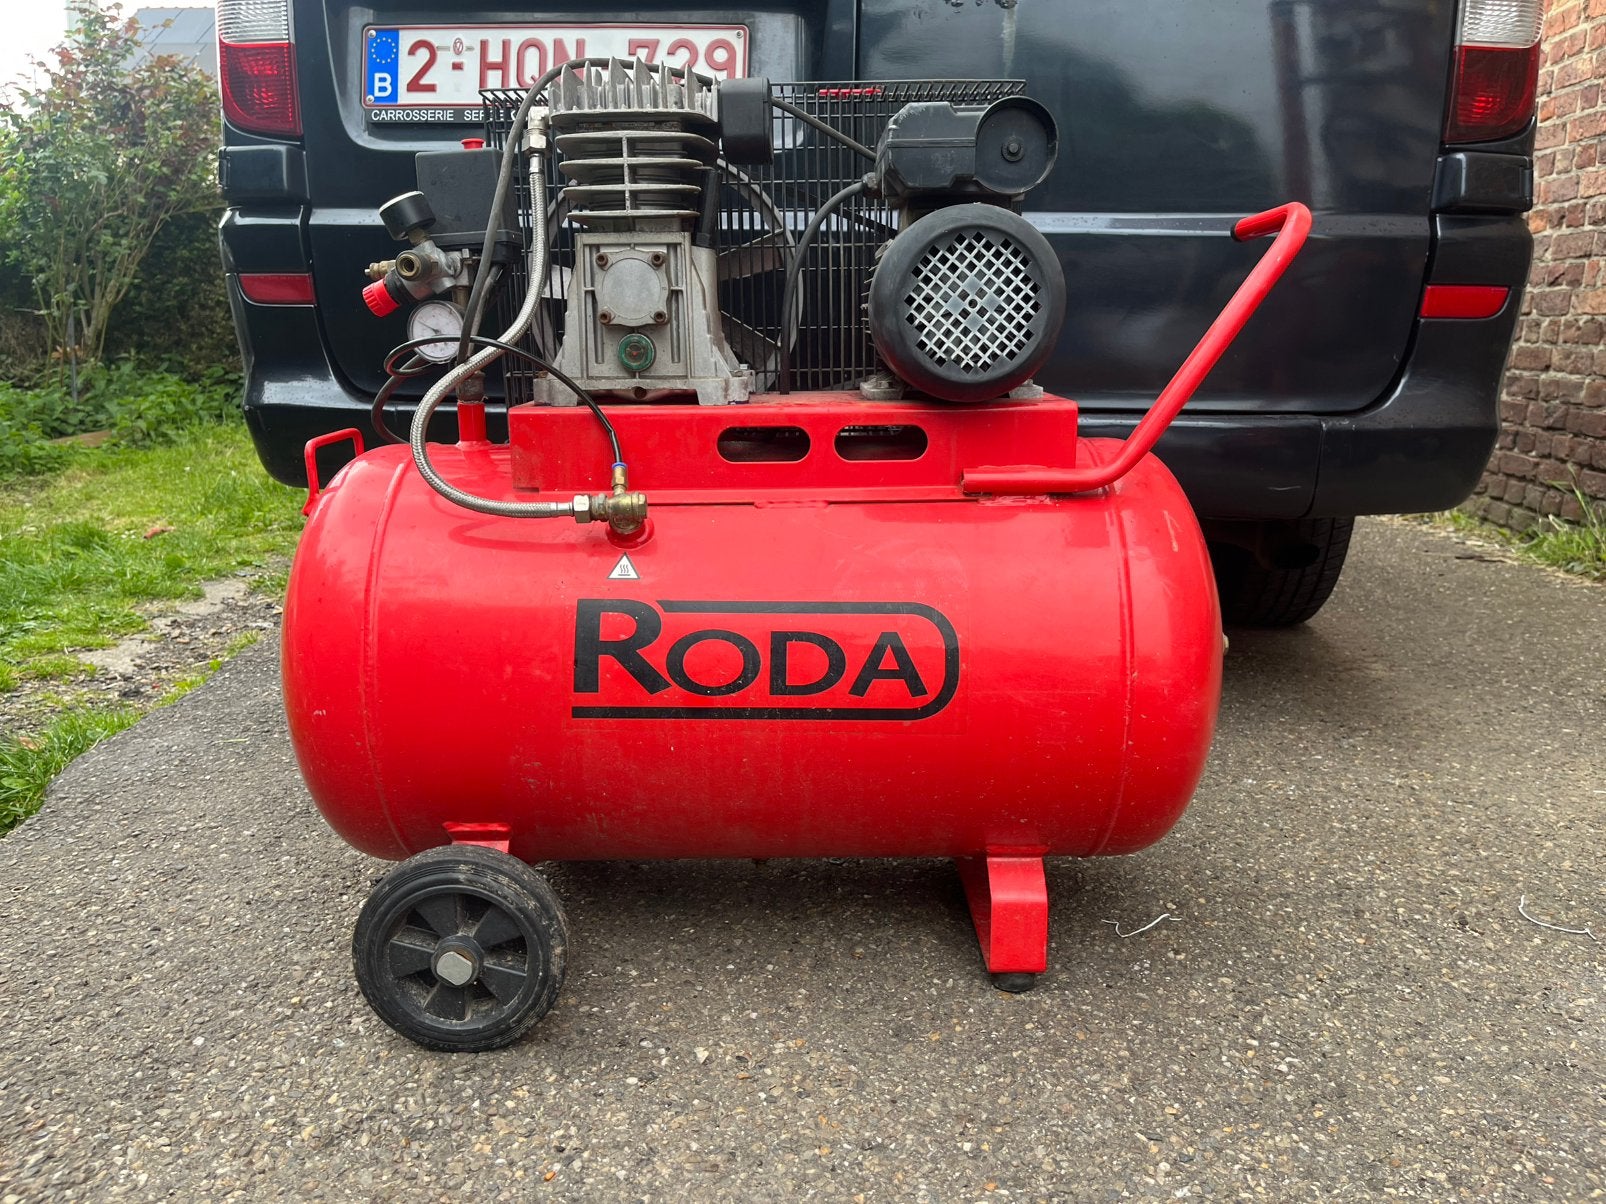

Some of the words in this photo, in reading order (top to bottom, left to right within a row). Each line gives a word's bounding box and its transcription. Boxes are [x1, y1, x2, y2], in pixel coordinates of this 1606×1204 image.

[373, 73, 392, 98] B
[406, 38, 737, 93] 2-HQN729
[371, 110, 454, 121] CARROSSERIE
[573, 599, 928, 698] RODA
